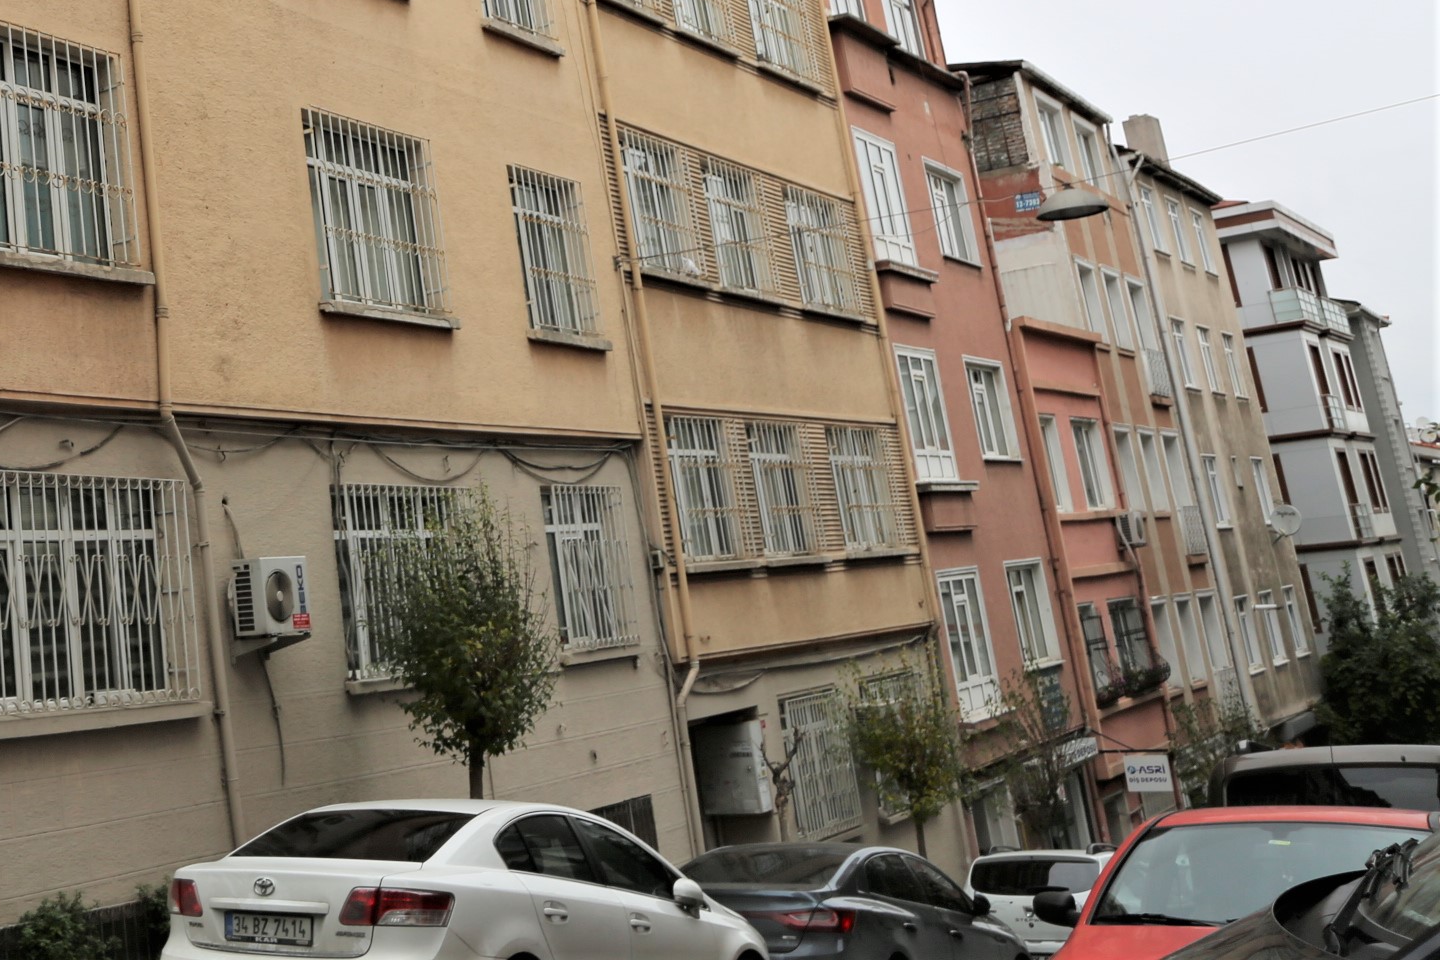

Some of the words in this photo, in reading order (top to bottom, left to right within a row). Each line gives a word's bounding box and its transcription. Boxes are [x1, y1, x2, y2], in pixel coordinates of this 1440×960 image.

[295, 564, 307, 614] BEKO
[233, 916, 248, 933] 34
[253, 916, 268, 936] BZ
[274, 918, 306, 938] 7414
